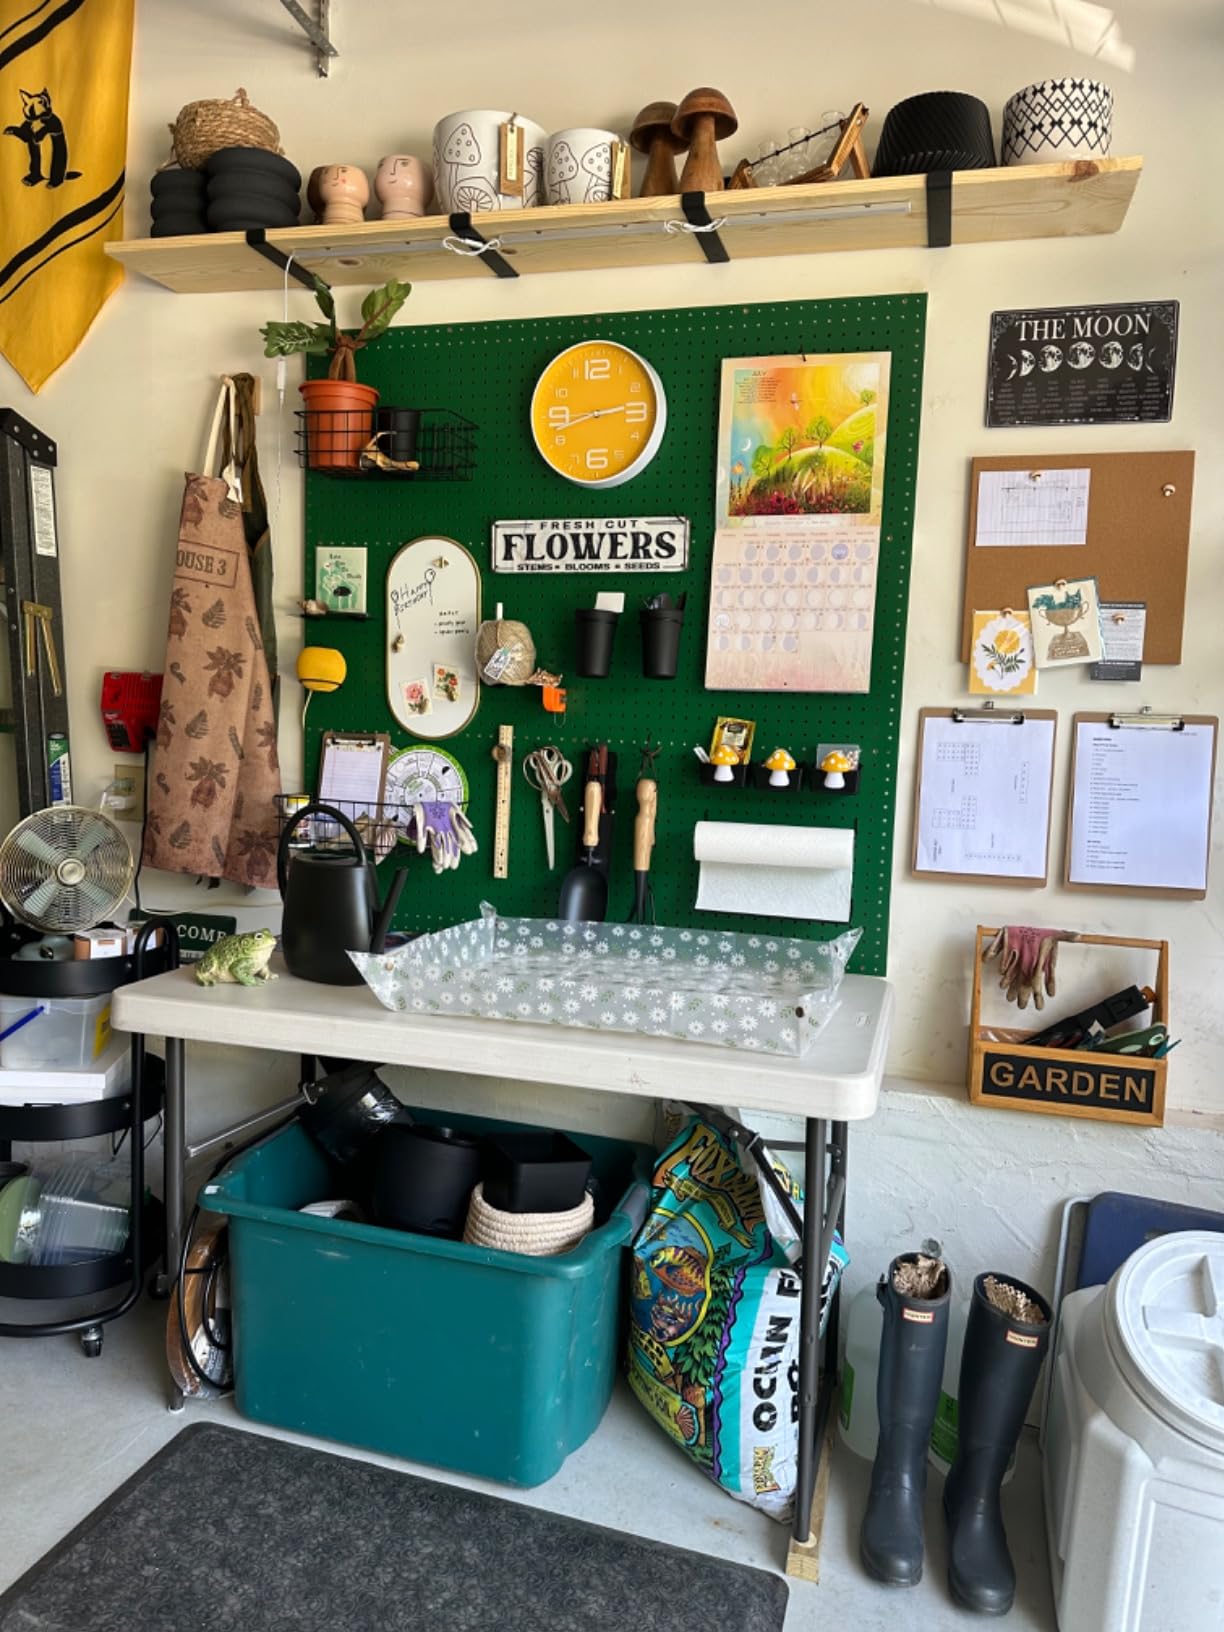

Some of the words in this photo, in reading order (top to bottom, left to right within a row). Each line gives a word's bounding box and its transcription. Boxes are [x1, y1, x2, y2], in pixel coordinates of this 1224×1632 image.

[1015, 318, 1066, 341] THE
[1071, 313, 1152, 339] MOON
[584, 359, 610, 380] 12
[555, 388, 568, 398] 10
[548, 406, 570, 428] 9
[625, 401, 647, 423] 3
[586, 448, 609, 470] 6
[540, 521, 595, 530] FRESH
[605, 519, 639, 529] CUT
[502, 530, 677, 561] FLOWERS
[217, 558, 226, 576] 3
[517, 563, 553, 571] STEMS
[565, 562, 610, 571] BLOOMS
[624, 561, 660, 570] SEEDS
[989, 1061, 1147, 1103] GARDEN
